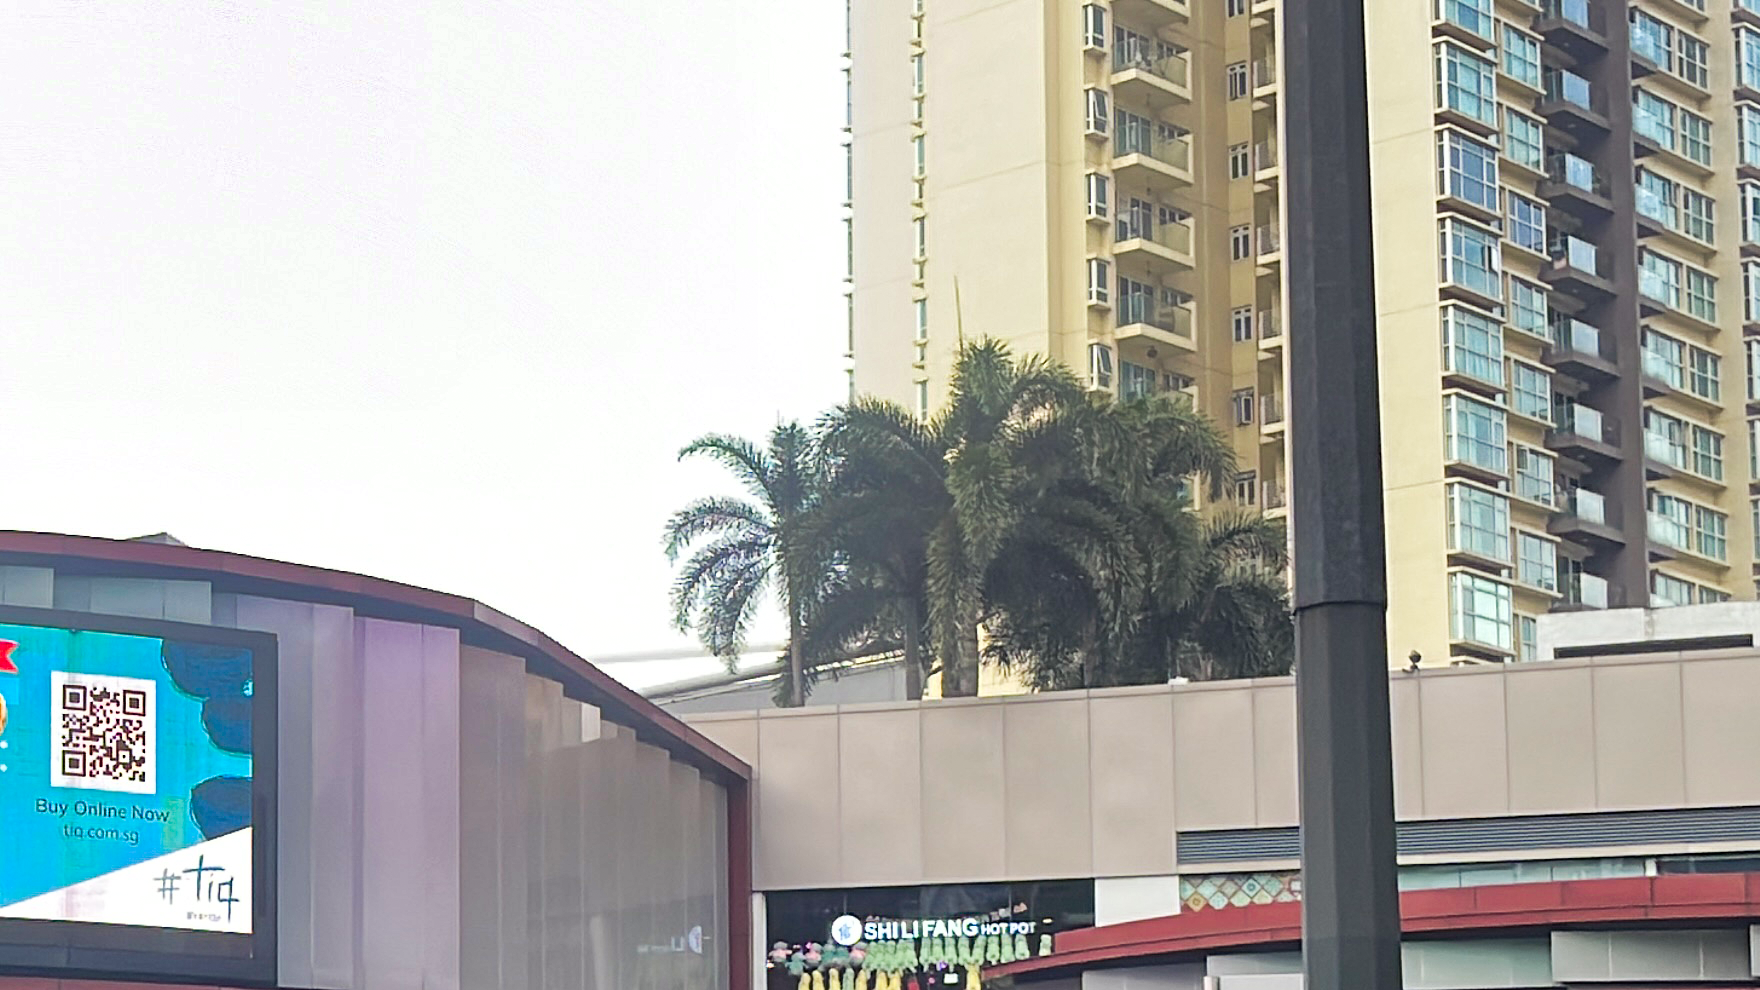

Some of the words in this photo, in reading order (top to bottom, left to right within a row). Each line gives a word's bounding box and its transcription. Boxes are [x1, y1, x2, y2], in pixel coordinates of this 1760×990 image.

[35, 798, 68, 818] Buy
[74, 801, 127, 818] Online
[132, 805, 170, 822] Now
[864, 921, 899, 940] SHI
[922, 918, 979, 937] FANG
[980, 924, 1008, 936] HOT
[1009, 922, 1036, 935] POT
